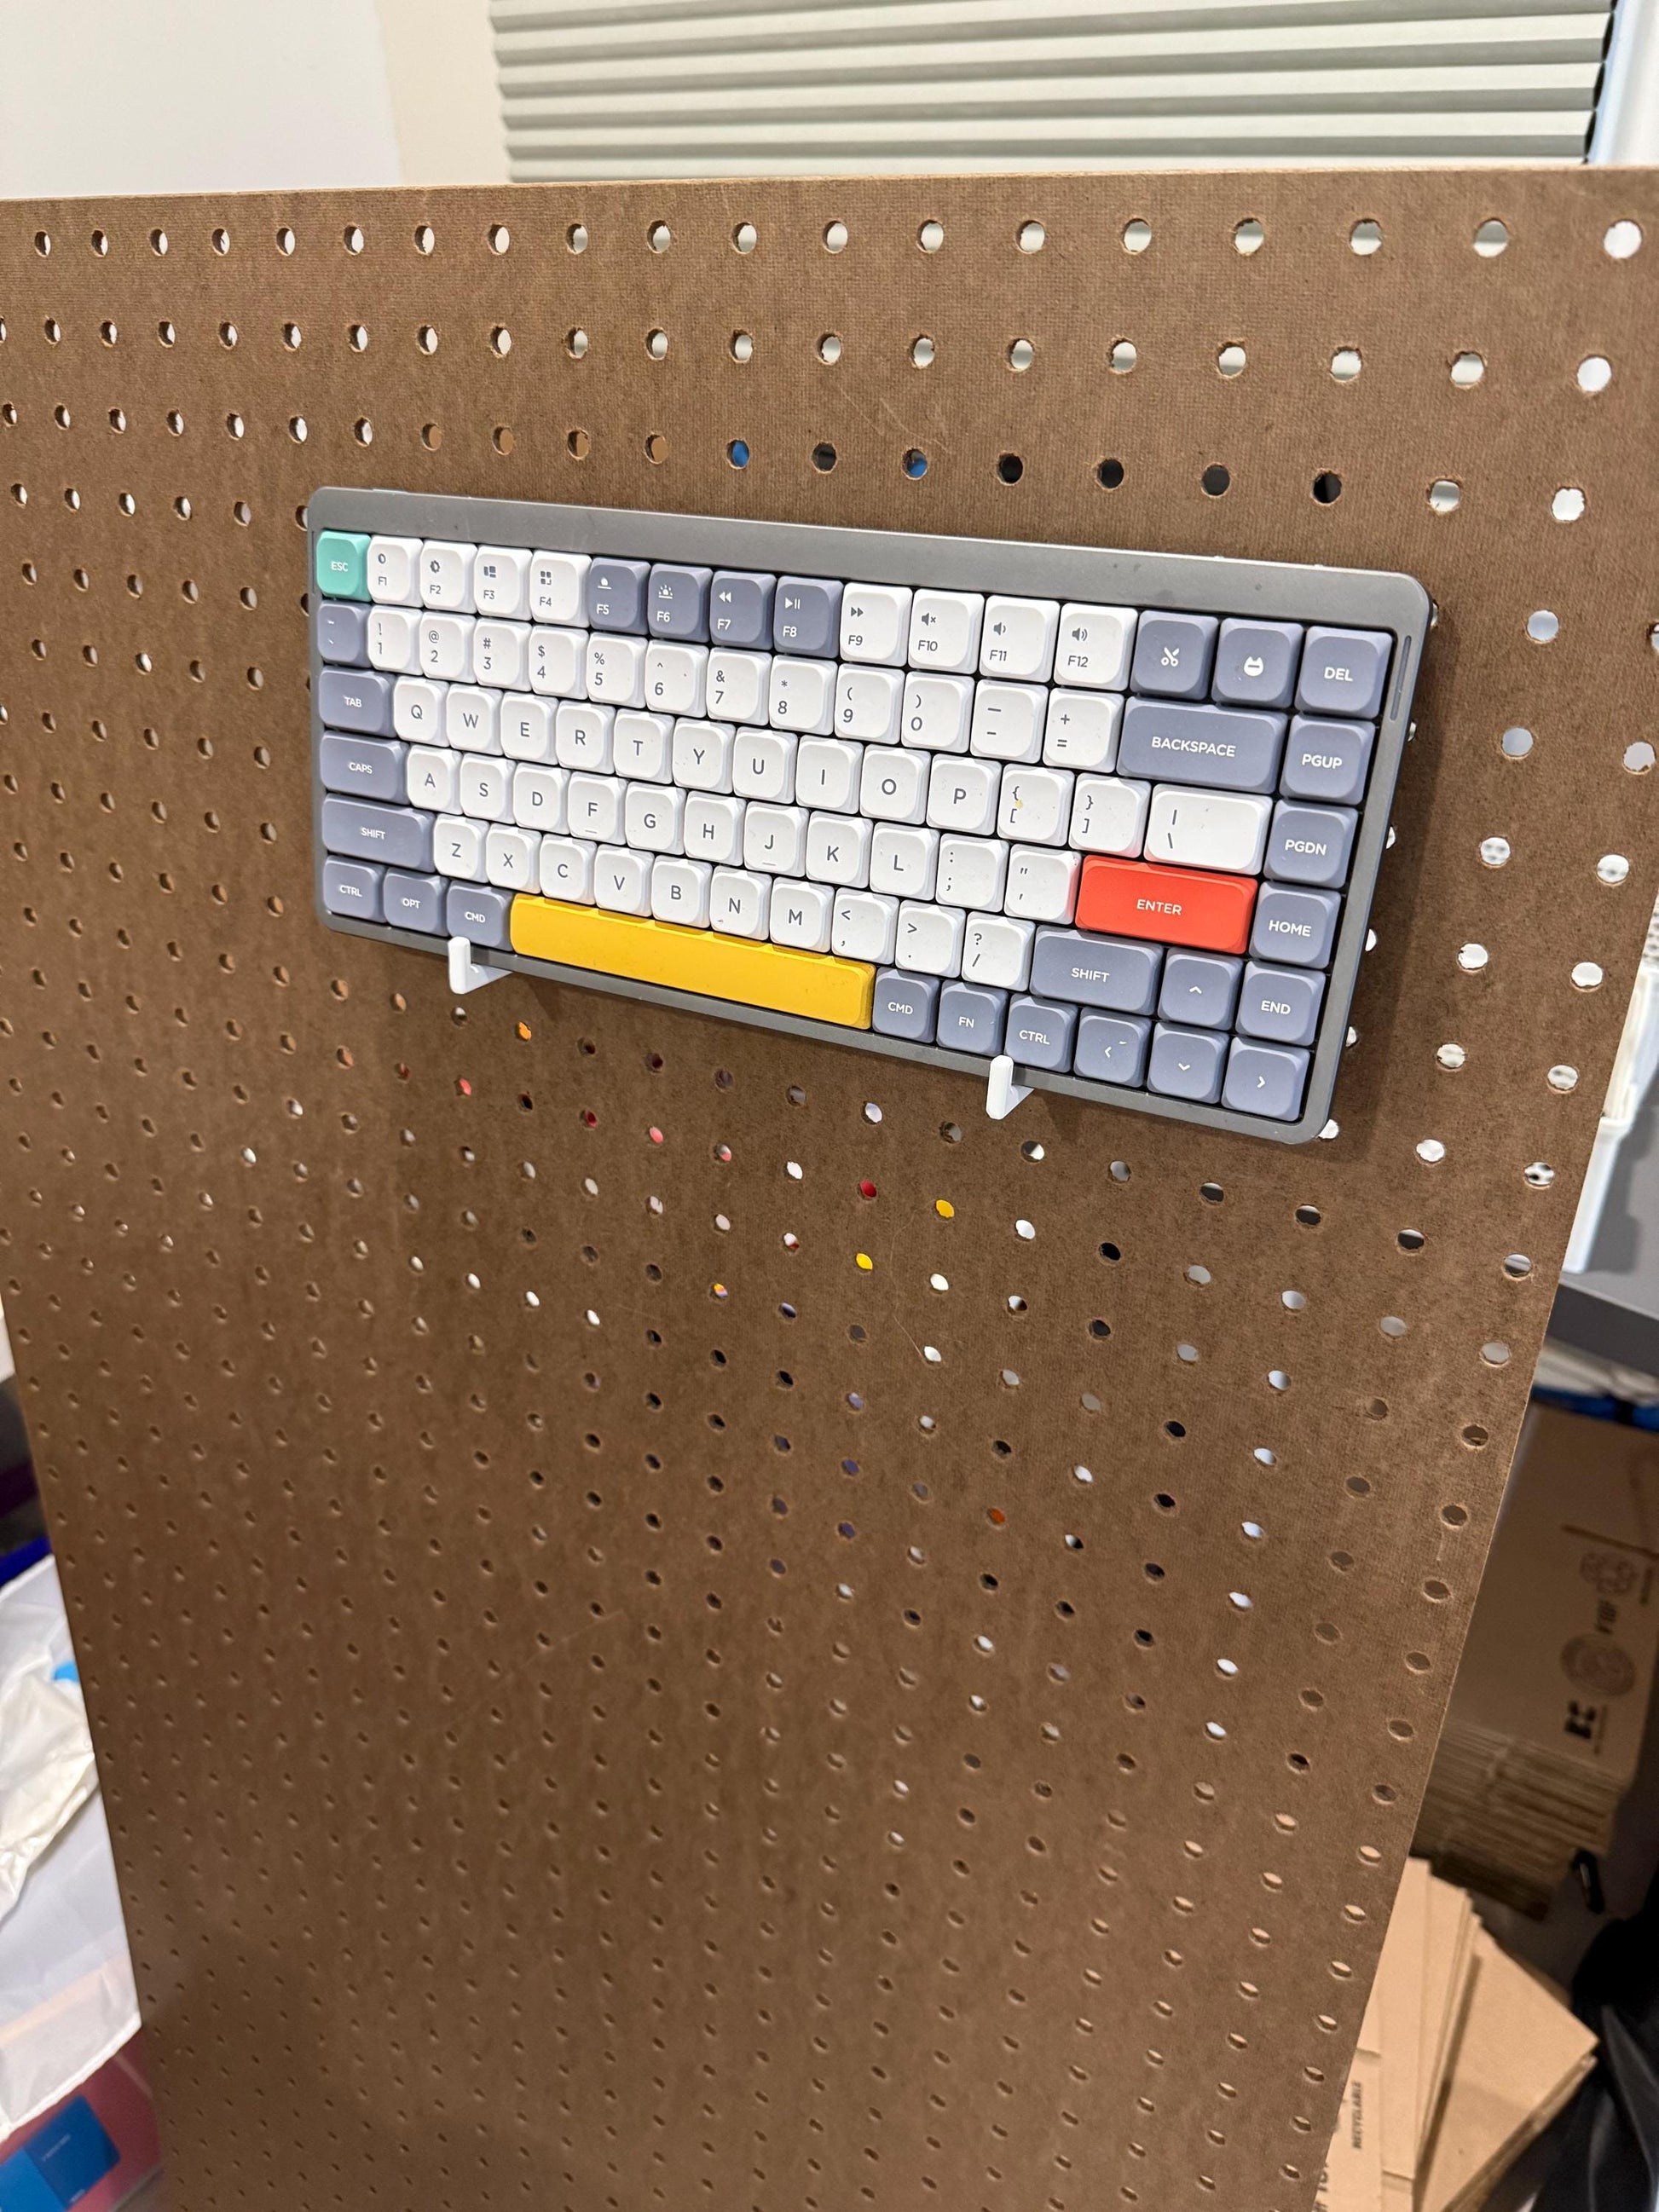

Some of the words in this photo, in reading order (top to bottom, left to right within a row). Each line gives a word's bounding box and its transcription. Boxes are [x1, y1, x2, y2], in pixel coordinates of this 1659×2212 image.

[331, 563, 348, 571] ESC
[378, 577, 387, 586] F1
[430, 585, 441, 594] F2
[483, 590, 494, 599] F3
[540, 597, 552, 606] F4
[597, 604, 610, 615] F5
[657, 612, 670, 622] F6
[718, 620, 731, 630] F7
[783, 627, 797, 637] F8
[848, 635, 863, 645] F9
[918, 640, 938, 651] F10
[378, 643, 382, 654] 1
[431, 650, 438, 662] 2
[989, 650, 1007, 661] F11
[1067, 656, 1089, 667] F12
[483, 657, 491, 669] 3
[537, 667, 546, 679] 4
[595, 673, 603, 685] 5
[1324, 667, 1353, 682] DEL
[655, 683, 663, 695] 6
[344, 697, 362, 707] TAB
[715, 691, 724, 704] 7
[411, 705, 423, 719] Q
[778, 701, 787, 713] 8
[463, 713, 478, 728] W
[843, 709, 853, 723] 9
[521, 723, 529, 736] E
[910, 717, 922, 731] 0
[575, 730, 586, 745] R
[633, 740, 643, 755] T
[1152, 736, 1236, 757] BACKSPACE
[693, 749, 704, 765] Y
[1302, 754, 1342, 770] PGUP
[349, 762, 373, 774] CAPS
[753, 759, 764, 774] U
[425, 773, 435, 788] A
[821, 770, 825, 785] I
[479, 783, 488, 797] S
[882, 779, 897, 794] O
[533, 792, 543, 806] D
[953, 788, 966, 804] P
[588, 803, 598, 816] F
[644, 814, 656, 828] G
[361, 827, 385, 840] SHIFT
[703, 823, 714, 840] H
[765, 835, 774, 849] J
[1285, 839, 1327, 856] PGDN
[452, 844, 461, 858] Z
[827, 846, 839, 862] K
[503, 854, 512, 868] X
[893, 855, 904, 871] L
[558, 864, 568, 877] C
[614, 875, 625, 890] V
[340, 885, 361, 897] CTRL
[671, 886, 681, 899] B
[402, 898, 420, 909] OPT
[729, 898, 740, 914] N
[1137, 899, 1182, 915] ENTER
[465, 912, 485, 923] CMD
[789, 910, 802, 925] M
[1269, 921, 1311, 936] HOME
[1072, 967, 1109, 983] SHIFT
[888, 1002, 913, 1015] CMD
[1261, 1001, 1291, 1014] END
[958, 1017, 974, 1028] FN
[1020, 1030, 1050, 1045] CTRL
